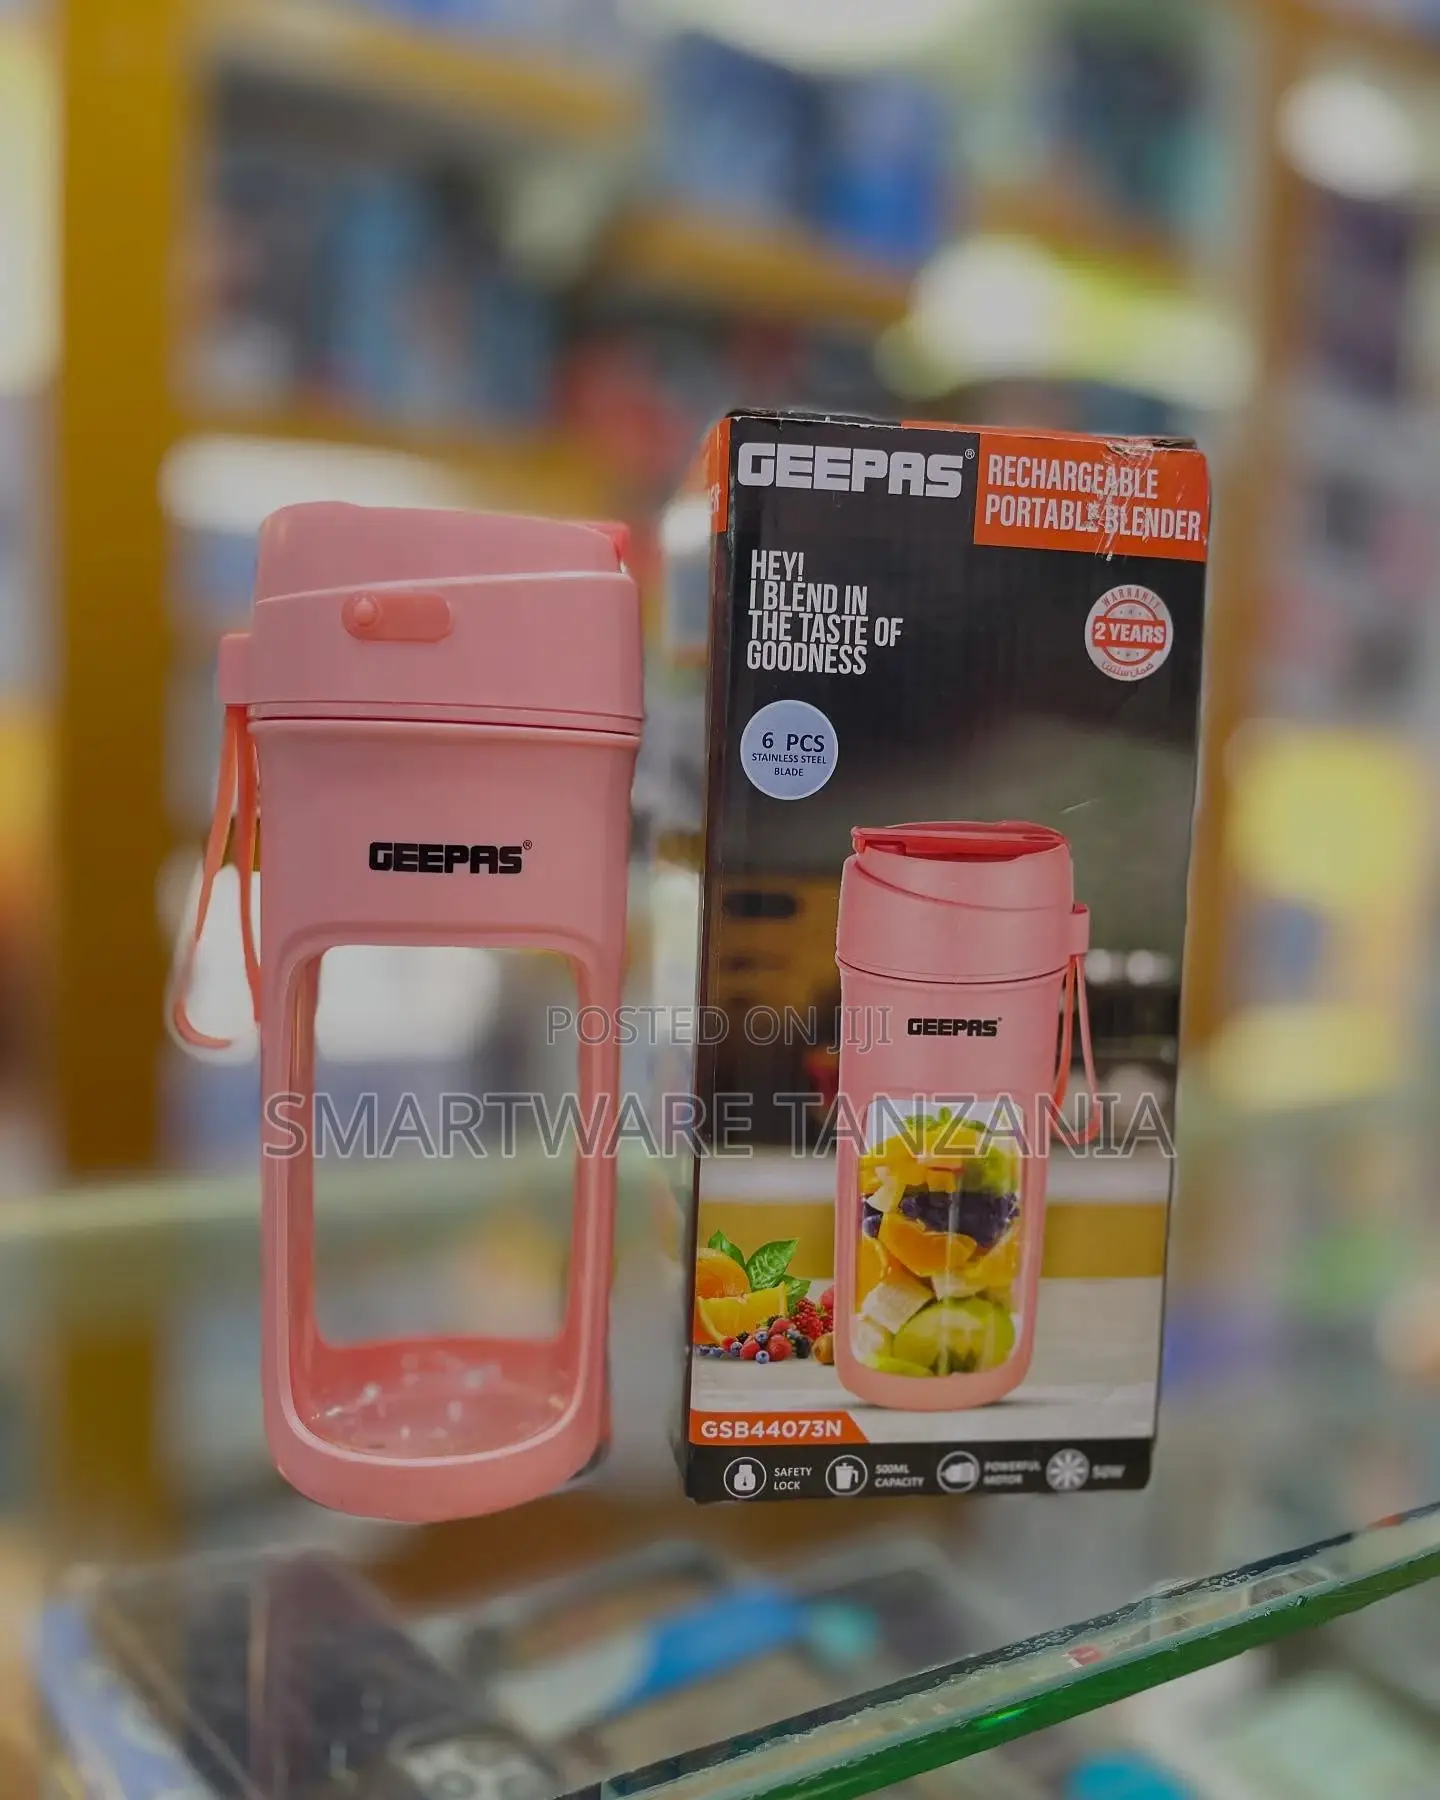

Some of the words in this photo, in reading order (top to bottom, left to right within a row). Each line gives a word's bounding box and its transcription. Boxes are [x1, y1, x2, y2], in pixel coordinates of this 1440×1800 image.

[988, 454, 1159, 500] RECHARGEABLE
[985, 494, 1099, 533] PORTABLE
[1104, 503, 1201, 541] BLENDER
[751, 550, 804, 581] HEY!
[749, 580, 757, 609] I
[763, 581, 838, 613] BLEND
[845, 585, 868, 615] IN
[1101, 587, 1162, 609] WARRANTY
[748, 610, 793, 641] THE
[799, 613, 868, 645] TASTE
[874, 617, 903, 647] OF
[1094, 622, 1106, 640] 2
[1109, 623, 1165, 644] YEARS
[747, 641, 867, 675] GOODNESS
[762, 732, 774, 749] 6
[786, 733, 825, 752] PCS
[752, 752, 799, 763] STAINLESS
[801, 755, 826, 764] STEEL
[774, 767, 804, 776] BLADE
[907, 1018, 998, 1037] GEEPAS
[701, 1419, 842, 1439] GSB44073N
[774, 1467, 812, 1477] SAFETY
[874, 1476, 925, 1488] CAPACITY
[774, 1480, 801, 1491] LOCK
